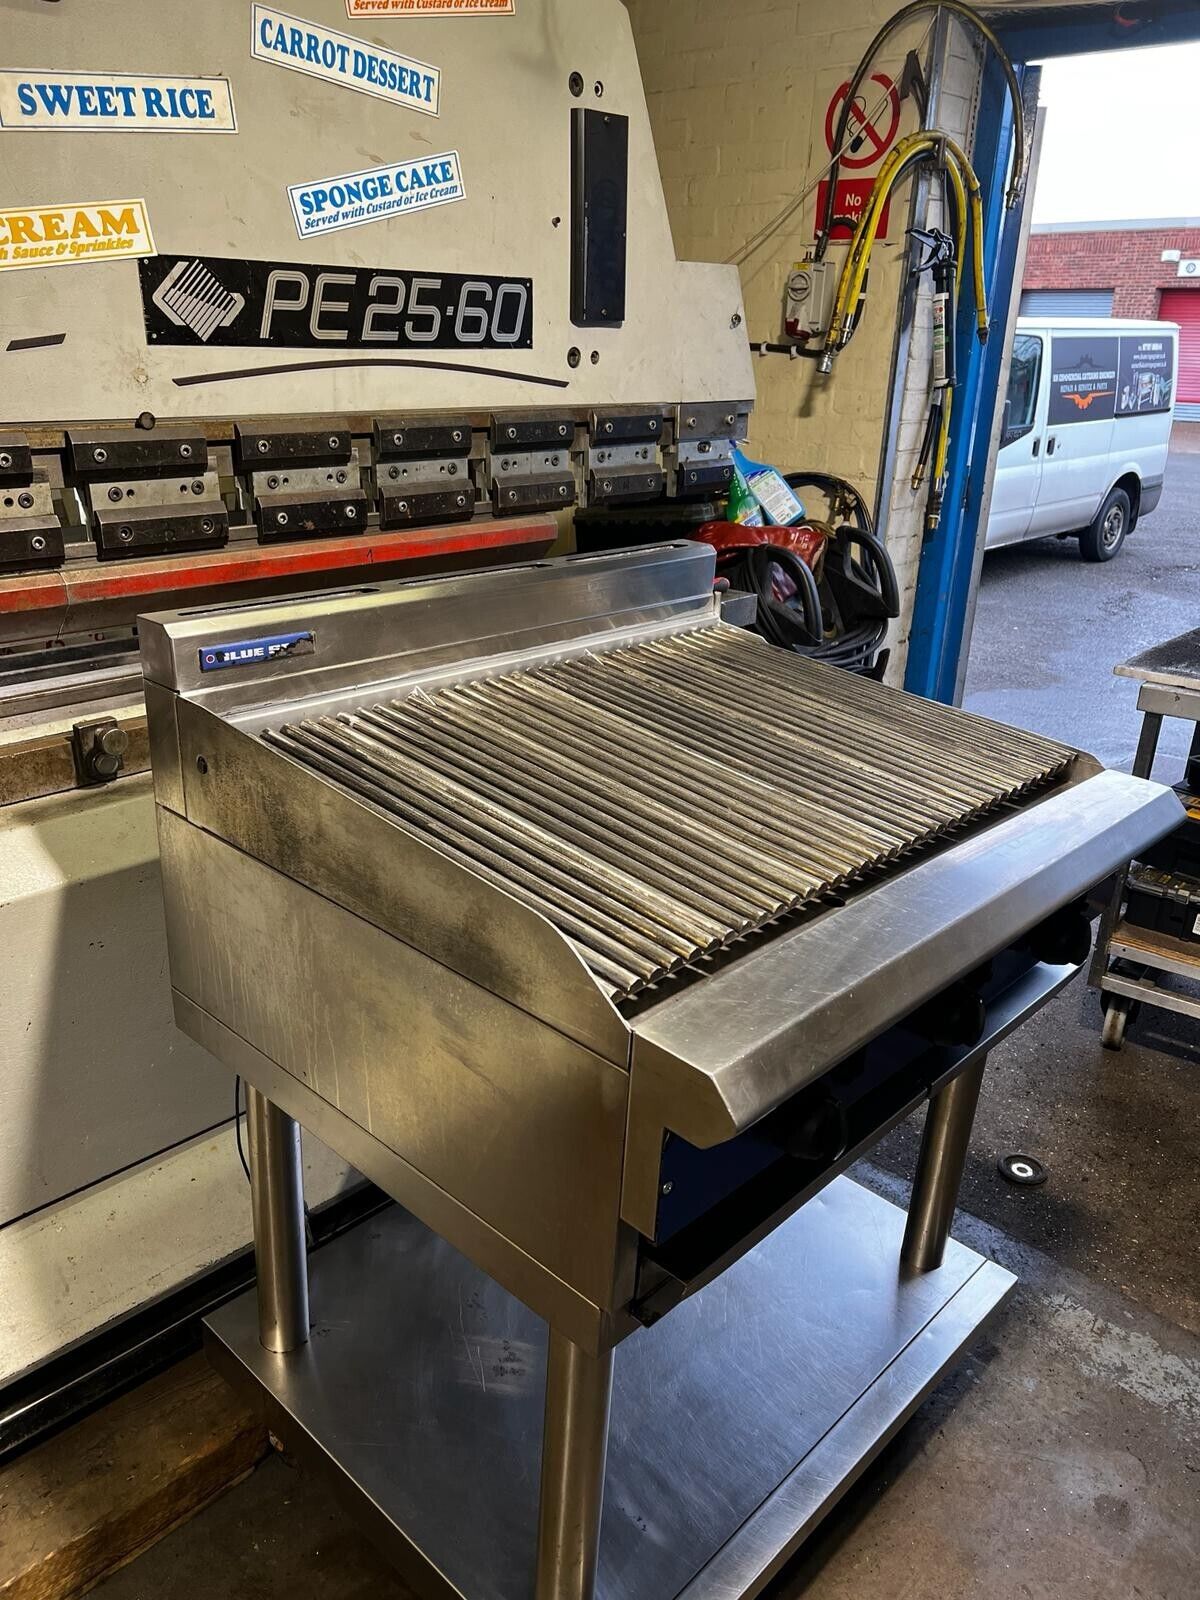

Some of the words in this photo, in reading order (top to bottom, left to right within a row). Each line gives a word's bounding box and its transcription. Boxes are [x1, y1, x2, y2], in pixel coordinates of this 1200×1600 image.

[353, 0, 388, 10] Served
[391, 0, 414, 9] with
[260, 18, 349, 73] CARROT
[353, 49, 435, 102] DESSERT
[17, 83, 136, 116] SWEET
[142, 87, 215, 118] RICE
[299, 174, 393, 215] SPONGE
[395, 161, 454, 193] CAKE
[845, 193, 861, 206] No
[304, 210, 340, 230] Served
[341, 204, 365, 219] with
[366, 196, 402, 215] Custard
[403, 194, 413, 206] or
[415, 191, 429, 202] Ice
[430, 184, 458, 199] Cream
[12, 244, 54, 260] Sauce
[55, 242, 68, 255] &
[69, 237, 134, 257] Sprinkles
[260, 269, 357, 339] PE
[217, 647, 264, 662] LUE
